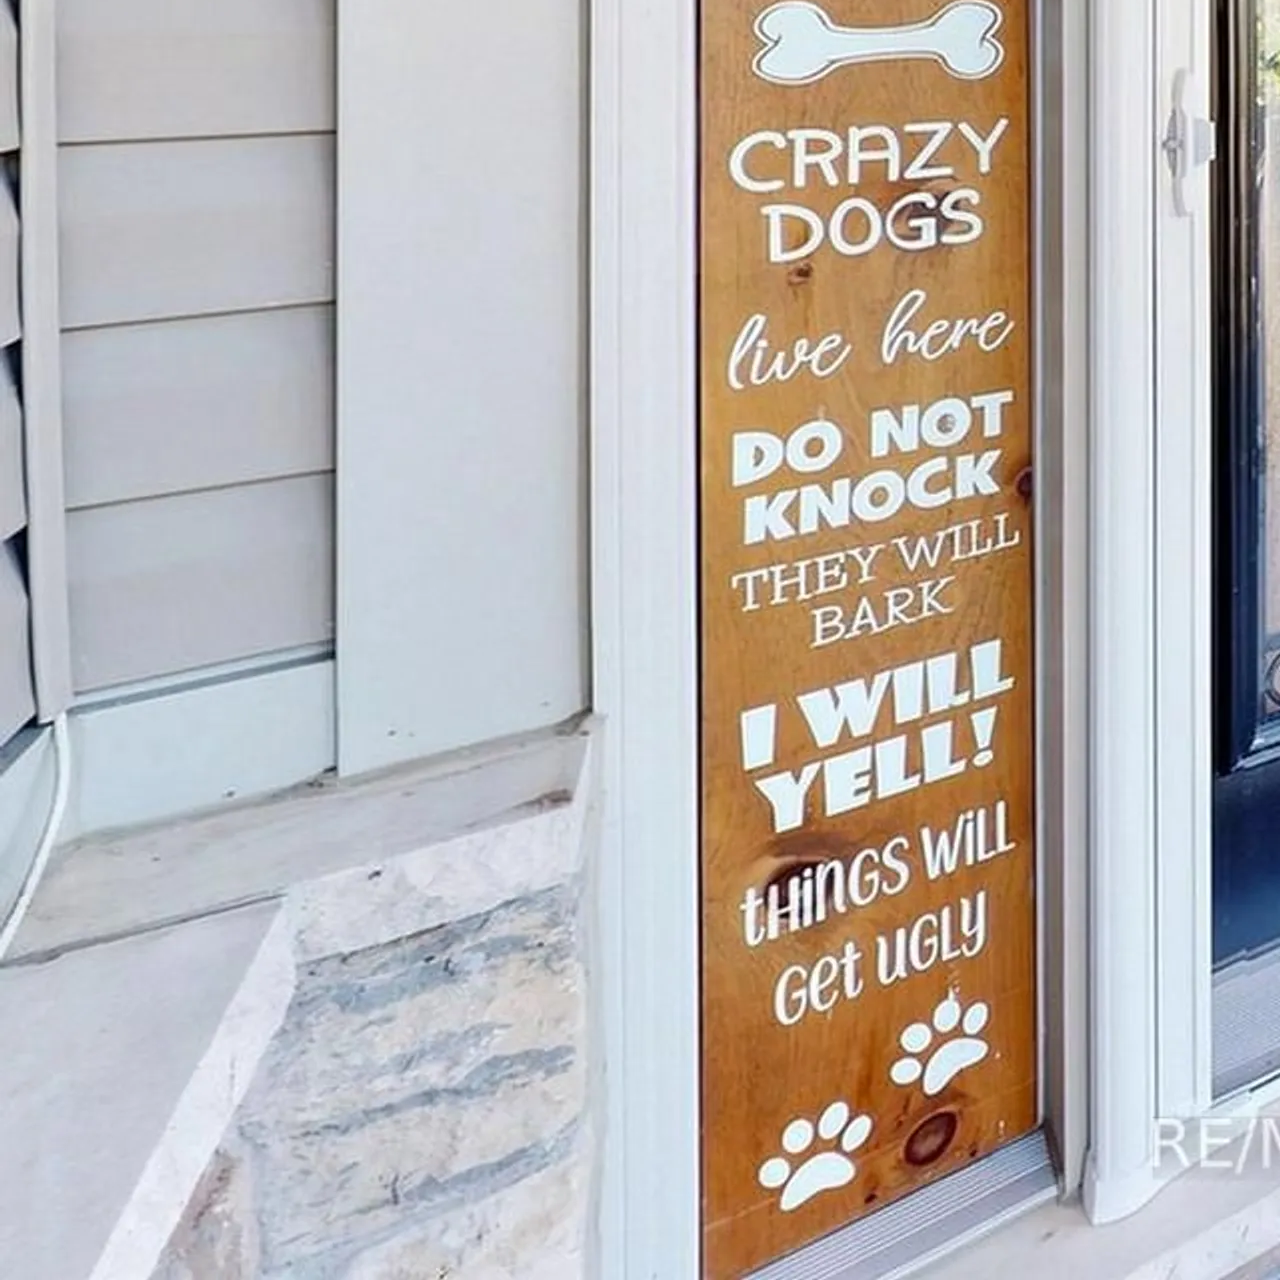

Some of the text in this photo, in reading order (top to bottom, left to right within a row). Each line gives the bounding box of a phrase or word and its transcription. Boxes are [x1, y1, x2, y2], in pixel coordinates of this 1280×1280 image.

[729, 118, 1009, 193] CRAZY
[761, 188, 985, 264] DOGS
[727, 289, 1014, 390] live here
[732, 391, 1014, 487] DO NOT
[743, 449, 1002, 546] KNOCK
[732, 512, 1021, 612] THEY WILL
[810, 576, 958, 648] BARK
[740, 639, 1014, 771] I WILL
[755, 706, 998, 833] YELL!
